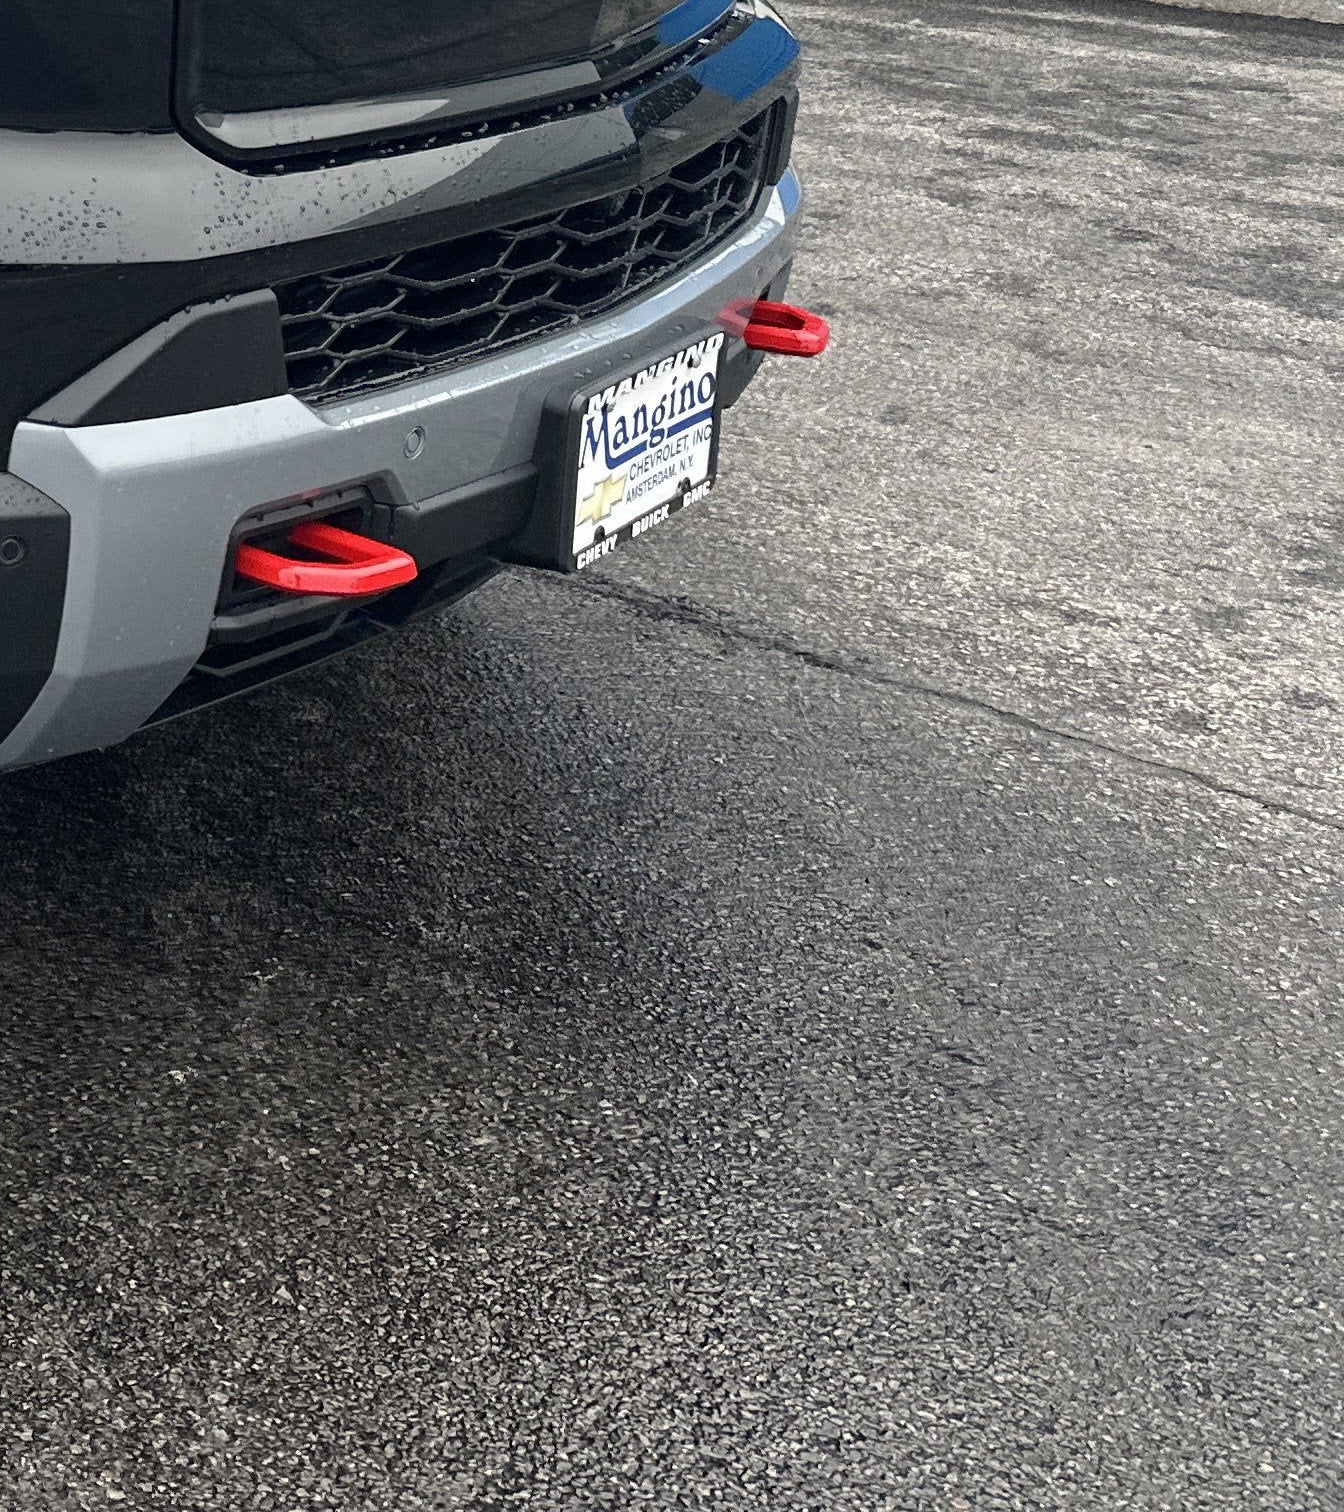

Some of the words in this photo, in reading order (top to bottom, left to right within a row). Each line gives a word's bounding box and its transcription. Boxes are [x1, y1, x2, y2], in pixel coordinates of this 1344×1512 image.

[578, 371, 717, 470] Mangino
[576, 533, 618, 570] CHEVY
[631, 503, 670, 538] BUICK
[682, 480, 711, 508] GMC
